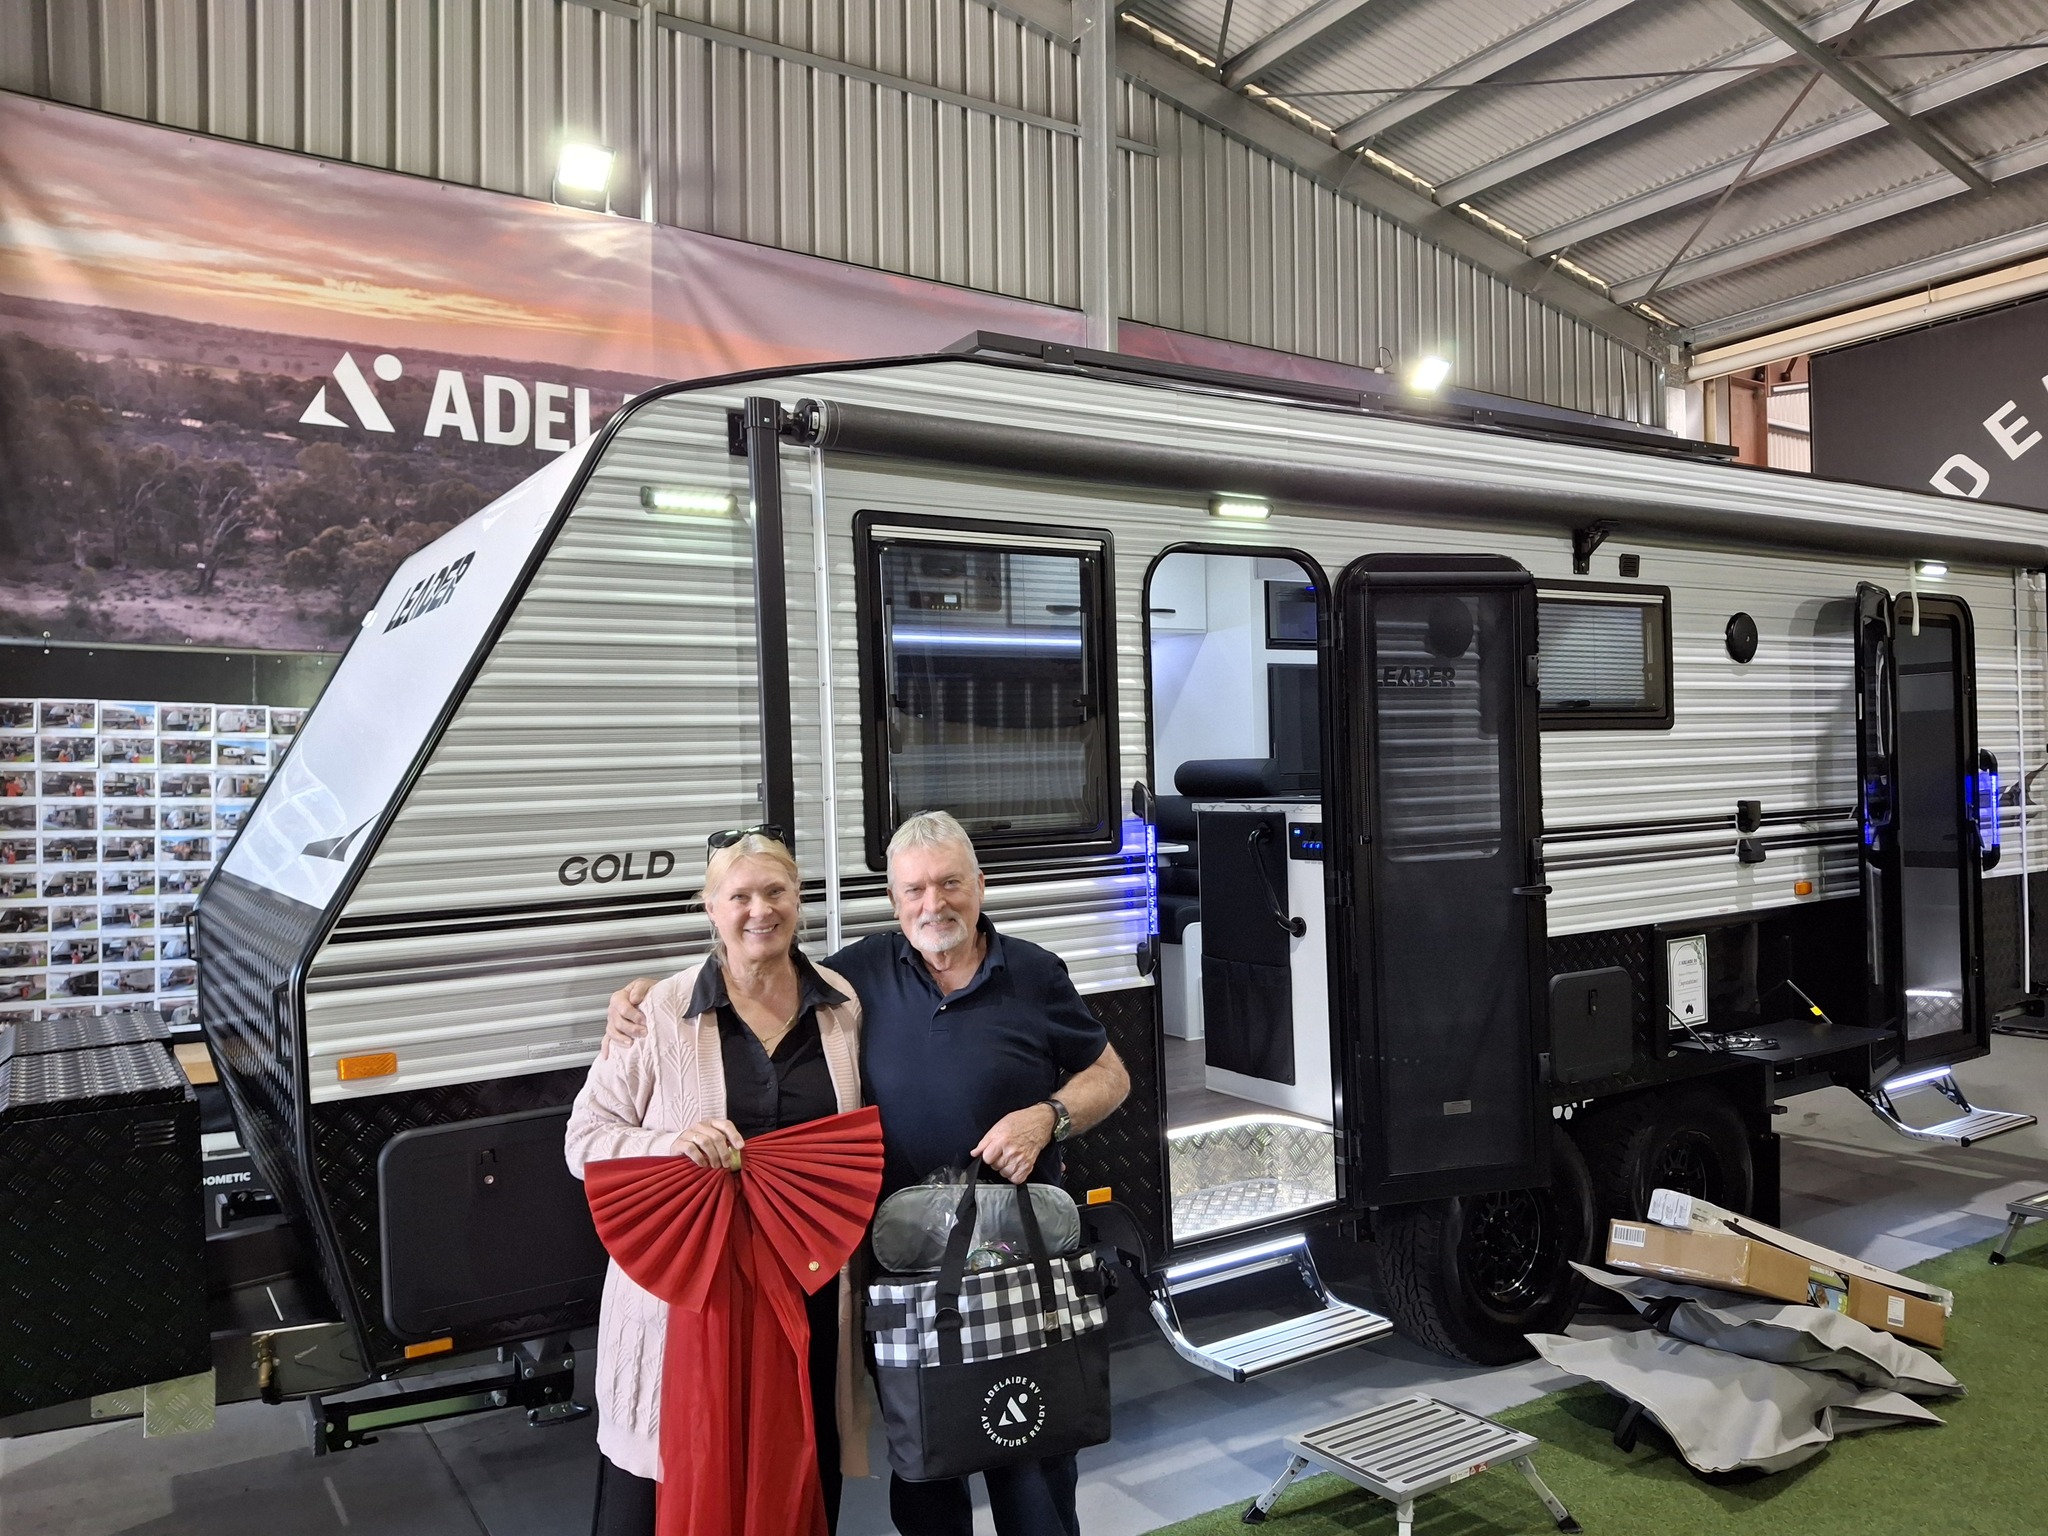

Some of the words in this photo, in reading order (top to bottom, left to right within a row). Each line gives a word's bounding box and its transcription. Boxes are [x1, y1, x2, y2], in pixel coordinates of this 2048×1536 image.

[423, 369, 638, 452] ADEL
[1928, 374, 2048, 499] DE
[382, 550, 476, 635] LEADER
[558, 850, 676, 886] GOLD
[984, 1376, 1028, 1405] ADELAIDE
[1028, 1381, 1041, 1394] RV
[981, 1415, 1028, 1447] ADVENTURE
[1029, 1404, 1046, 1438] READY
